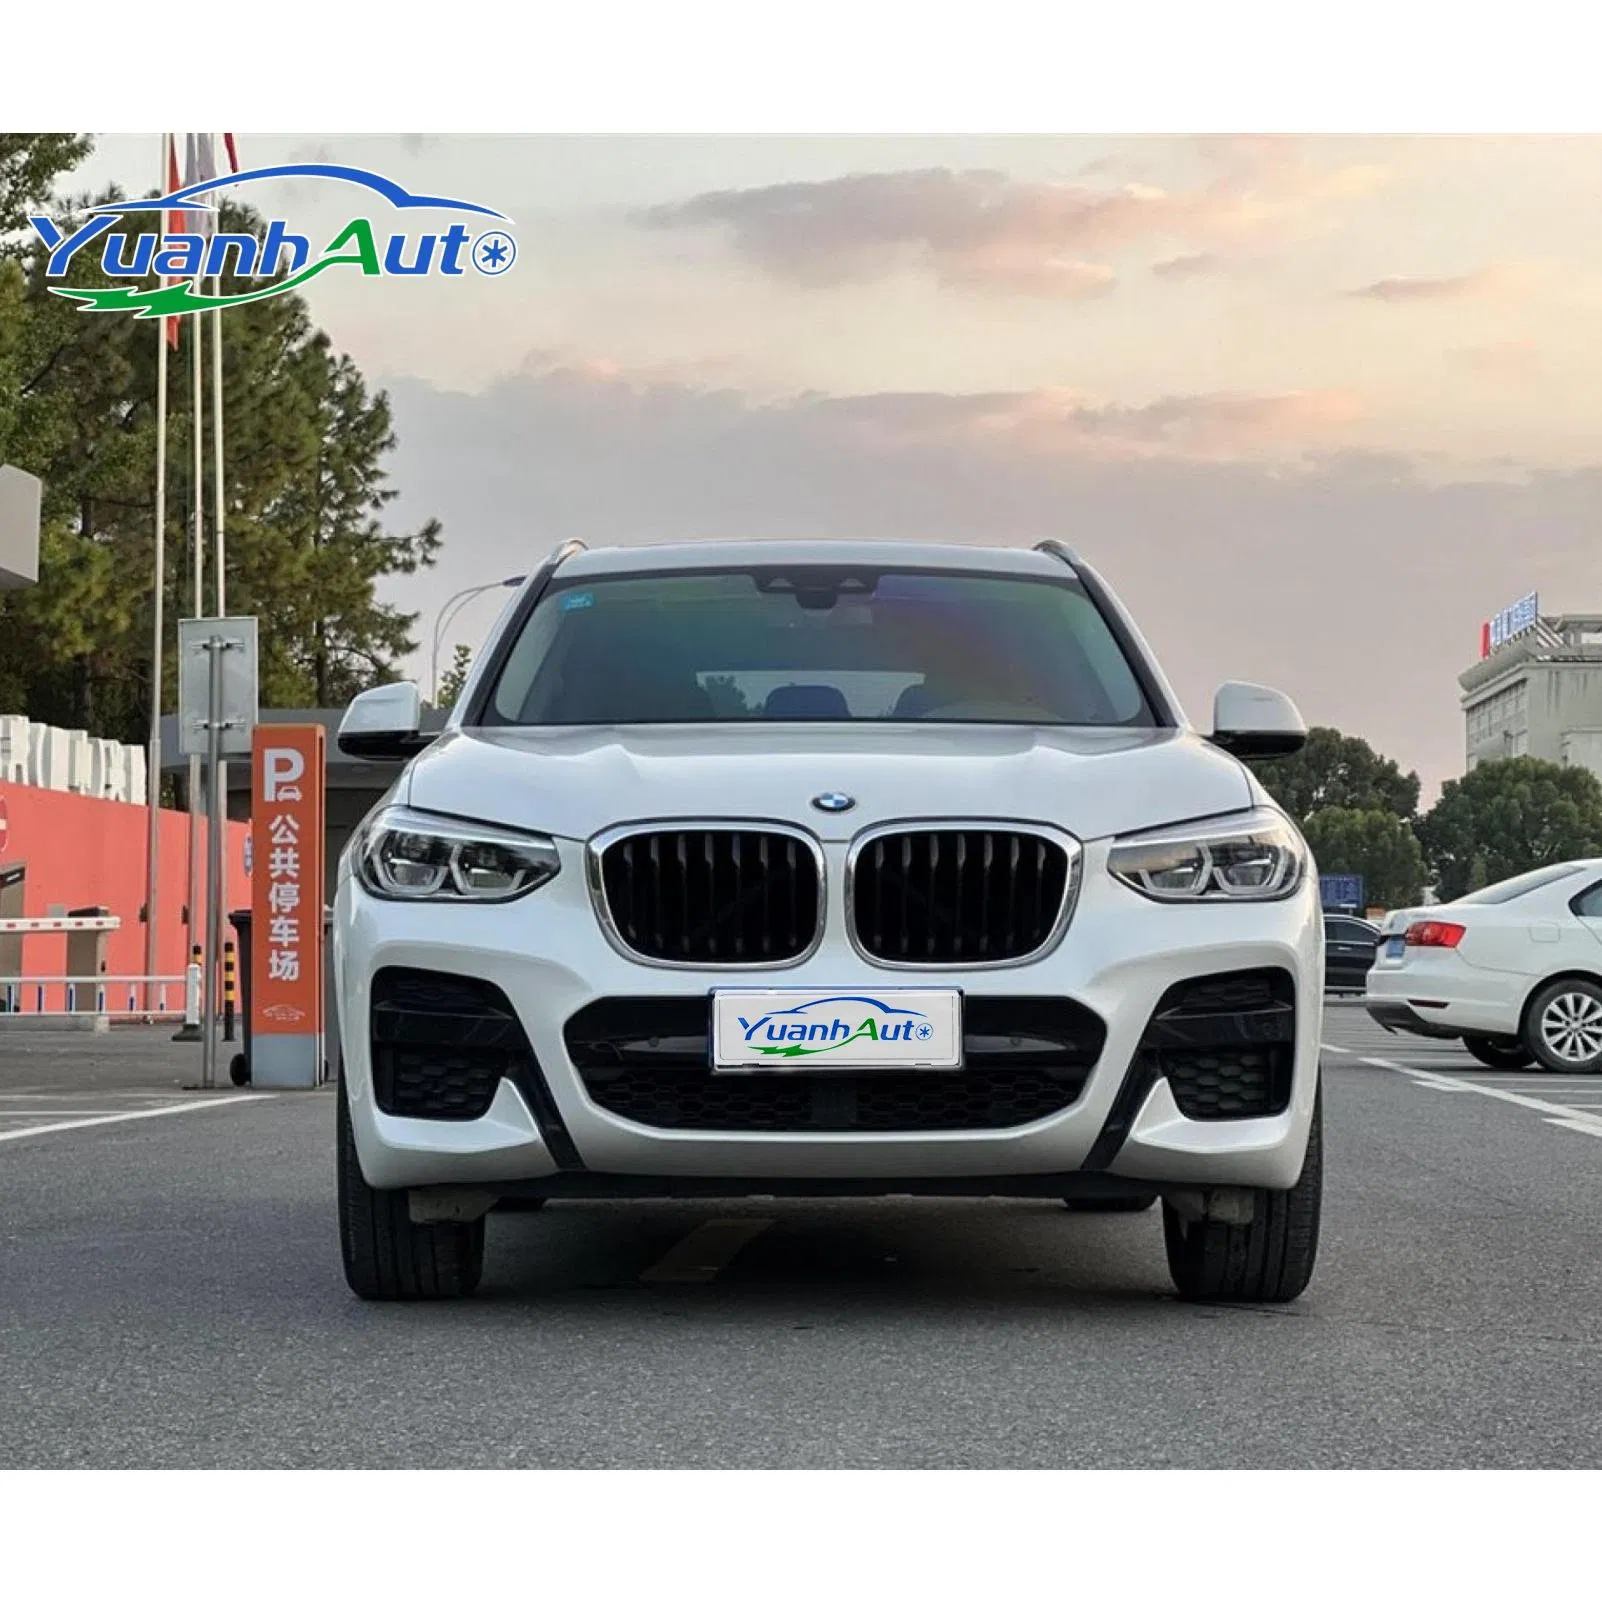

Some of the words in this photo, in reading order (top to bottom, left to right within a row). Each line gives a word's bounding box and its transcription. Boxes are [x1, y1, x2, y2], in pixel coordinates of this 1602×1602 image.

[264, 748, 304, 801] P
[268, 814, 300, 982] 公共停车场
